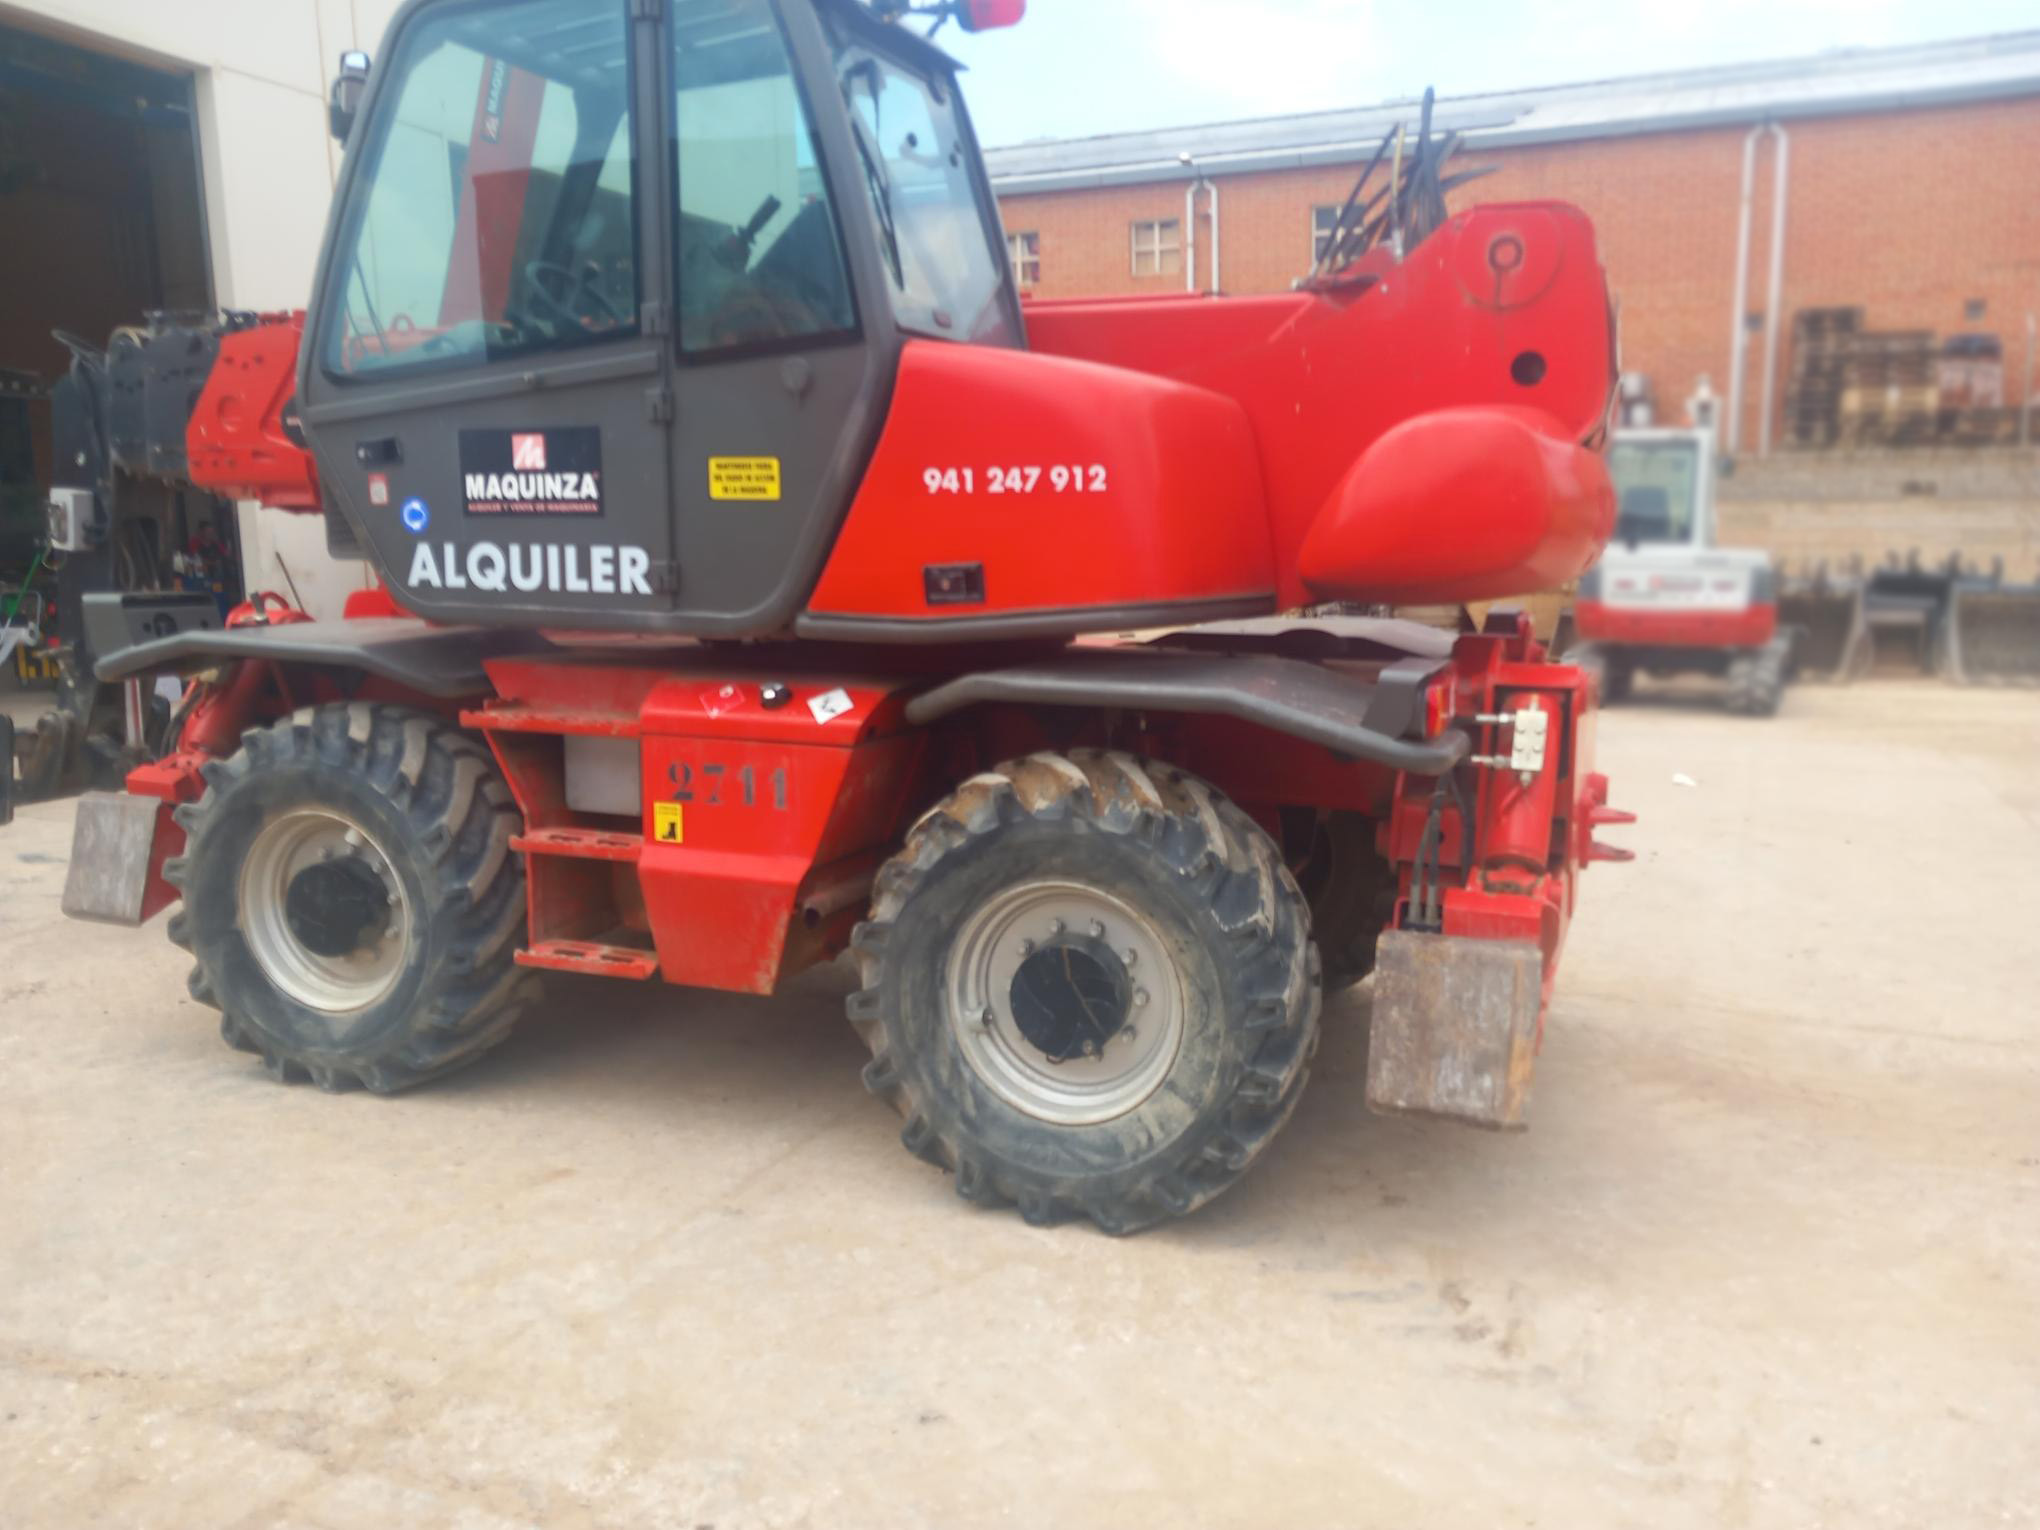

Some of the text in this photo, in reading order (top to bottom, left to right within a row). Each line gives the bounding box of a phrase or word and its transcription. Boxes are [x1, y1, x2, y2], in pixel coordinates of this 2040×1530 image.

[465, 472, 598, 501] MAQUINZA
[923, 464, 1107, 494] 941 247 912
[408, 541, 652, 595] ALQUILER
[668, 761, 788, 811] 2711
